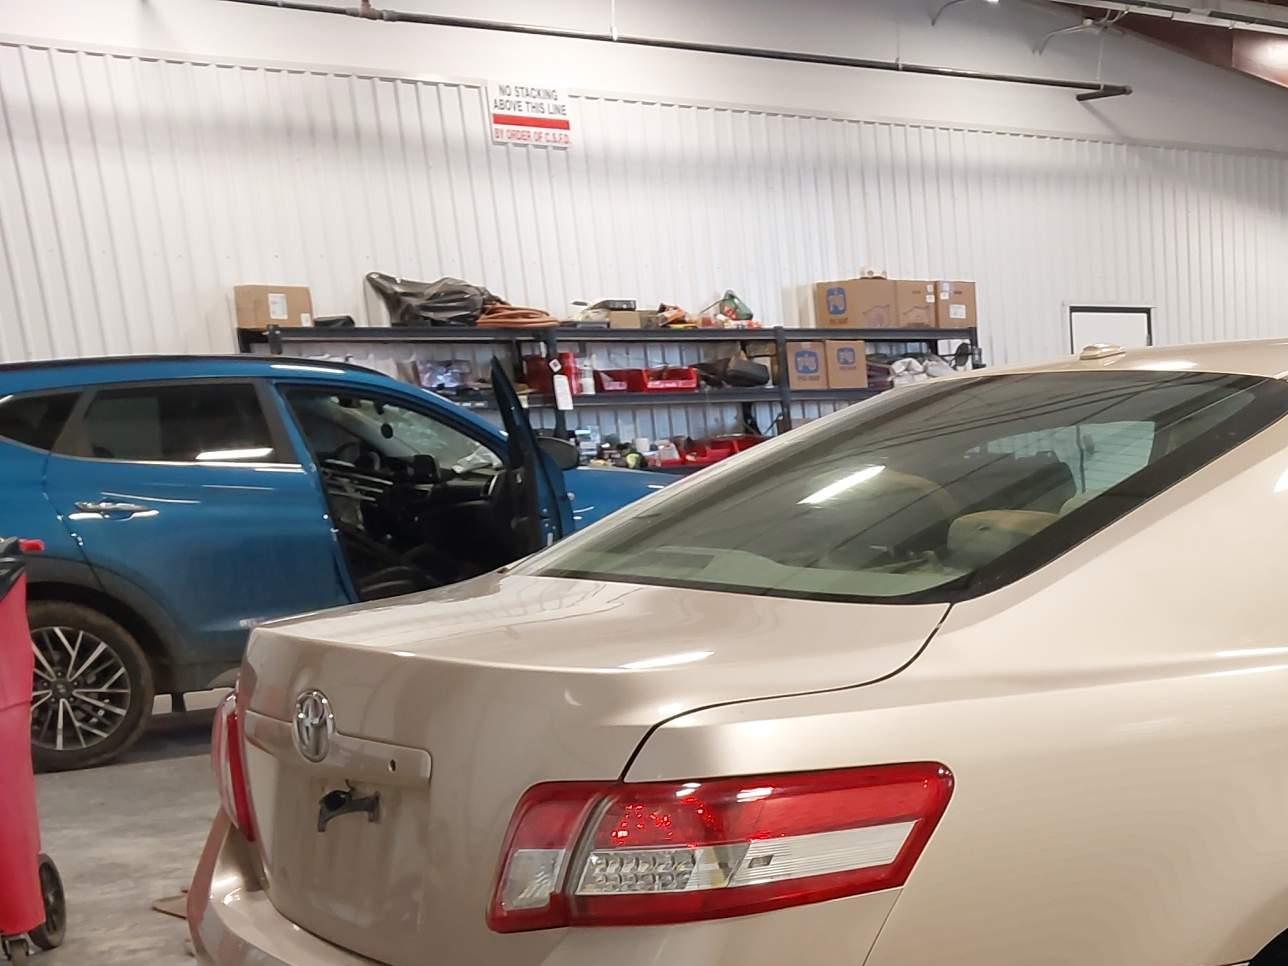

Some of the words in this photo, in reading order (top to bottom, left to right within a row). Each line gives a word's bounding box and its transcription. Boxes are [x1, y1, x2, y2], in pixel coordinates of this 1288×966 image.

[499, 85, 511, 96] NO
[514, 86, 558, 101] STACKING
[494, 98, 523, 112] ABOVE
[525, 101, 545, 114] THIS
[548, 103, 567, 116] LINE
